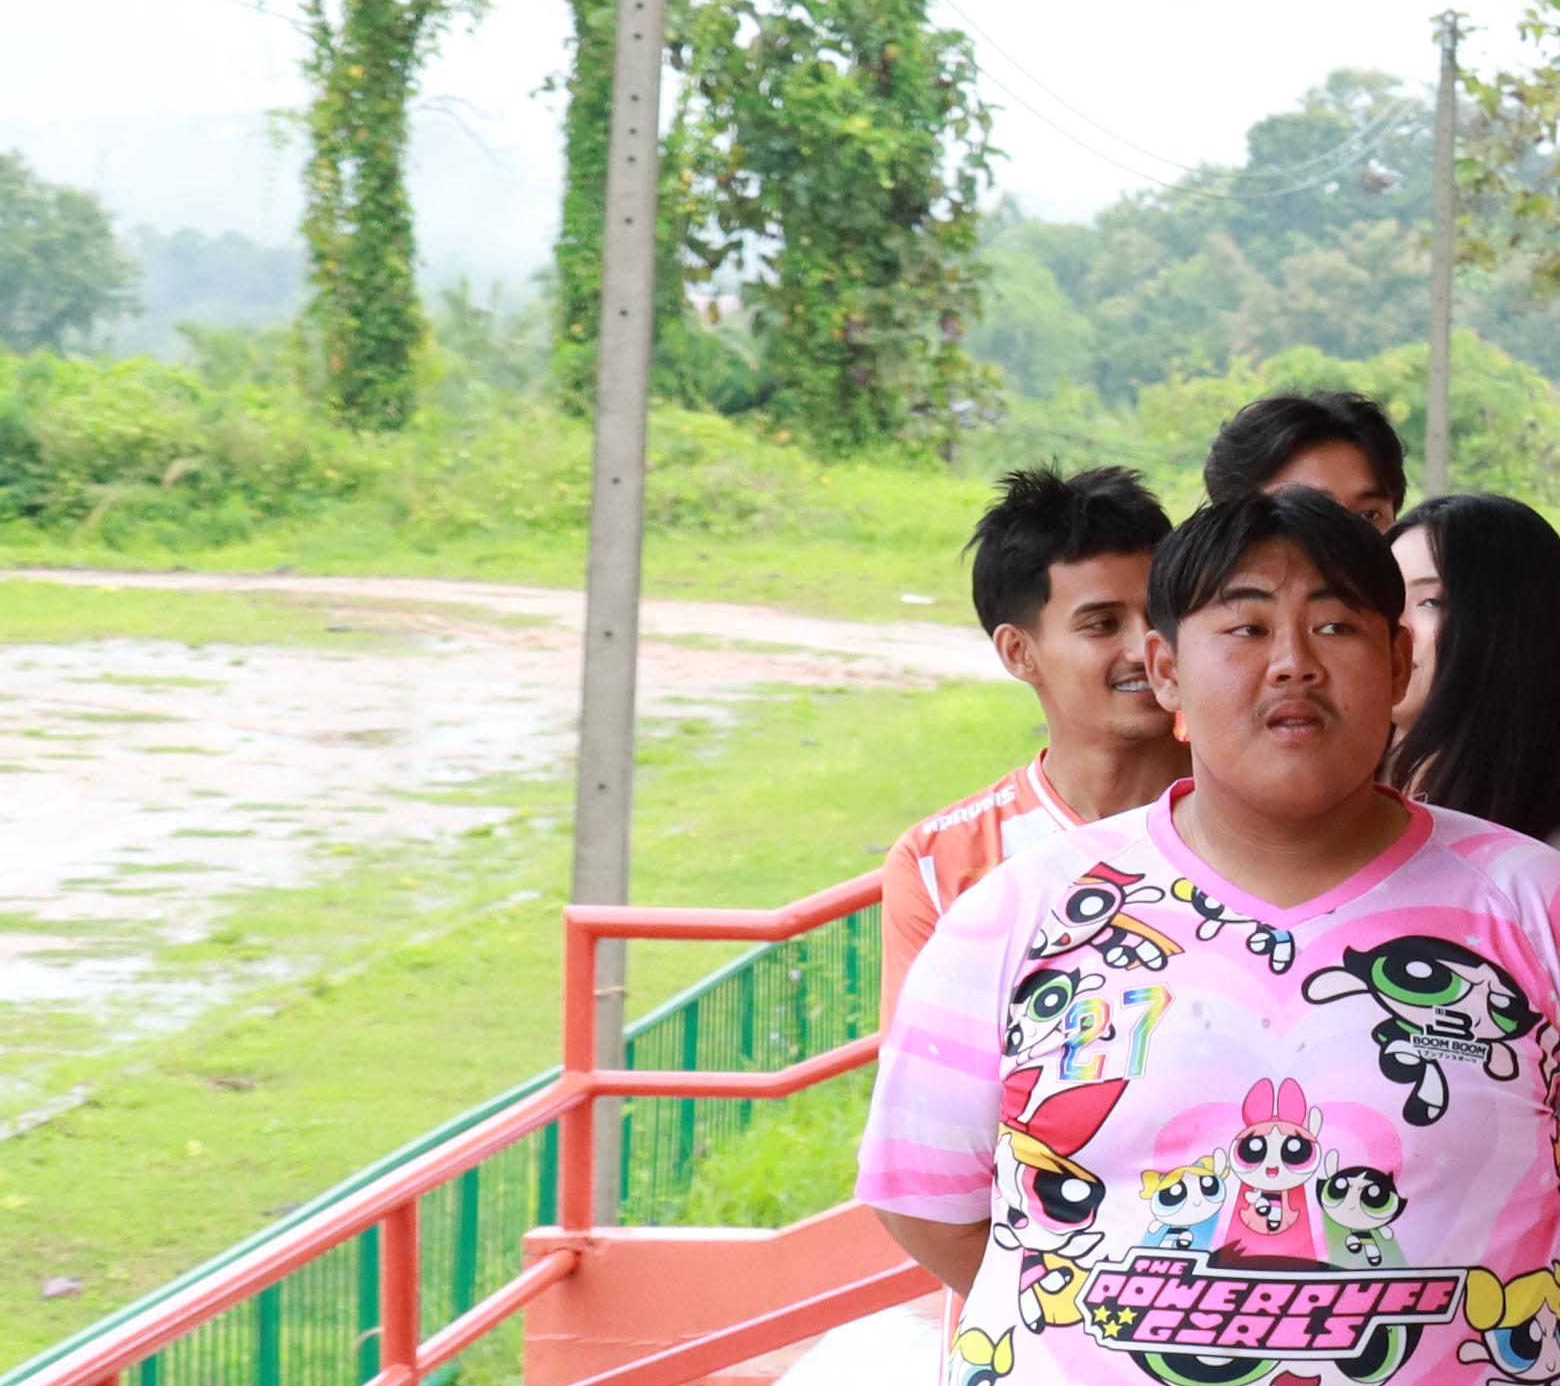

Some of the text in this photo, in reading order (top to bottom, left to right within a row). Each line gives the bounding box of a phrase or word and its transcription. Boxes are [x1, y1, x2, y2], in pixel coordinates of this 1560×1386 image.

[1056, 982, 1175, 1083] 27
[1413, 1036, 1450, 1049] BOOM
[1452, 1041, 1486, 1055] BOOM
[1134, 1259, 1189, 1276] THE
[1087, 1274, 1456, 1315] POWERPUFF
[1133, 1311, 1366, 1349] GIRLS
